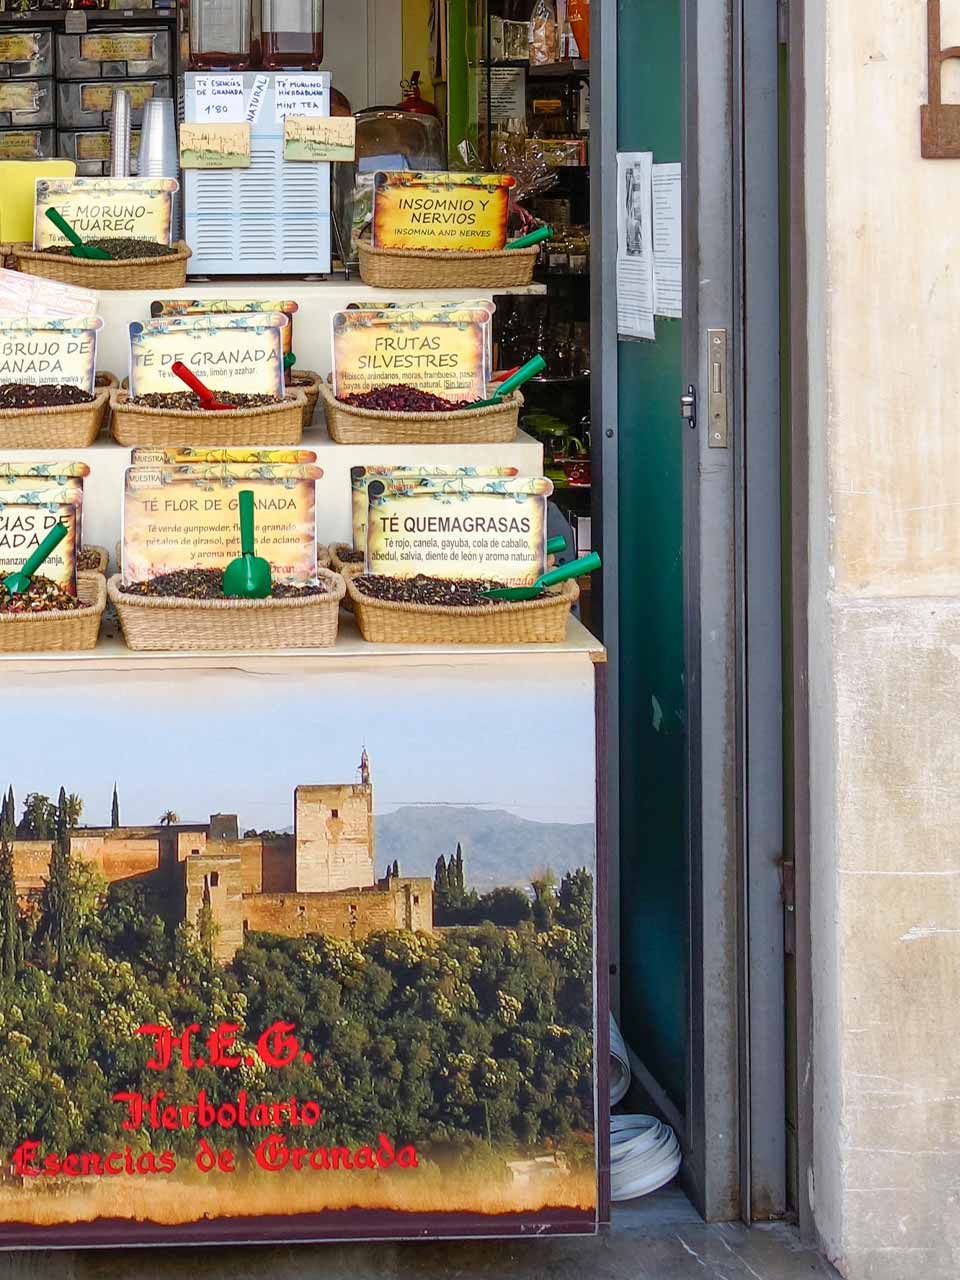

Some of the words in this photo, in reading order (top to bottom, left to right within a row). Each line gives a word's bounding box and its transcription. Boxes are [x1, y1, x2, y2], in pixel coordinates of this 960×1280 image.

[246, 78, 269, 123] NATURAL
[276, 101, 299, 109] MINT
[301, 101, 320, 109] TEA
[75, 205, 155, 219] MORUNO-
[398, 198, 474, 213] INSOMNIO
[479, 199, 490, 213] Y
[411, 212, 477, 225] NERVIOS
[71, 219, 135, 233] TUAREG
[394, 227, 436, 236] INSOMNIA
[438, 228, 457, 237] AND
[459, 229, 492, 238] NERVES
[67, 341, 90, 356] DE
[374, 336, 441, 352] FRUTAS
[134, 348, 155, 368] TÉ
[190, 349, 279, 367] GRANADA
[357, 353, 459, 370] SILVESTRES
[209, 368, 228, 378] limón
[134, 454, 166, 464] MUESTRA
[128, 474, 162, 483] MUESTRA
[141, 496, 160, 513] TÉ
[164, 498, 199, 512] FLOR
[204, 498, 223, 511] DE
[228, 497, 297, 511] GANADA
[147, 523, 158, 533] Té
[158, 523, 182, 533] verde
[183, 524, 231, 535] gunpowder,
[380, 512, 399, 533] TÉ
[403, 516, 531, 534] QUEMAGRASAS
[146, 536, 179, 546] pétalos
[180, 536, 192, 545] de
[193, 536, 225, 547] girasol,
[260, 536, 272, 544] de
[273, 535, 301, 544] aciano
[384, 537, 394, 548] Té
[395, 537, 412, 550] rojo,
[413, 537, 440, 549] canela,
[441, 537, 471, 551] gayuba,
[472, 537, 489, 548] cola
[490, 537, 500, 548] de
[501, 537, 530, 549] caballo,
[197, 550, 225, 559] aroma
[371, 550, 398, 562] abedul,
[400, 550, 424, 562] salvia,
[425, 550, 449, 561] diente
[450, 550, 460, 561] de
[461, 550, 477, 561] león
[485, 552, 510, 561] aroma
[134, 1019, 314, 1071] H.E.G.
[111, 1088, 322, 1131] Herbolario
[12, 1137, 177, 1178] Esencias
[195, 1135, 236, 1175] de
[253, 1131, 419, 1173] Granada
